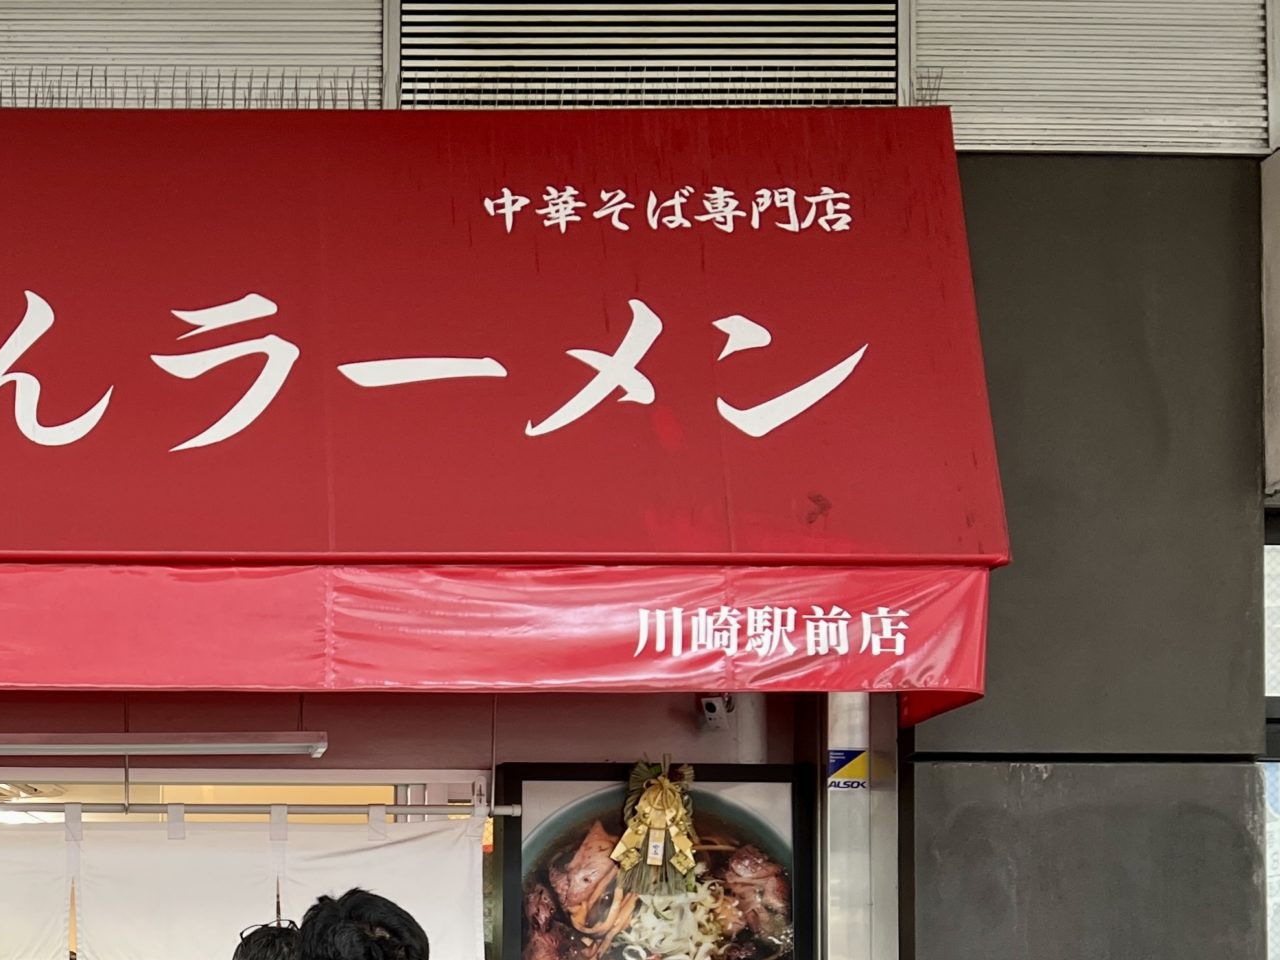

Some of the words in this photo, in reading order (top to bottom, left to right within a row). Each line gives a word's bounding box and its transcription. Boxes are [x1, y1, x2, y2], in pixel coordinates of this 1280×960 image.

[483, 186, 852, 234] 中華そば専門店
[633, 605, 910, 657] 川崎駅前店
[828, 781, 867, 789] ALSOK
